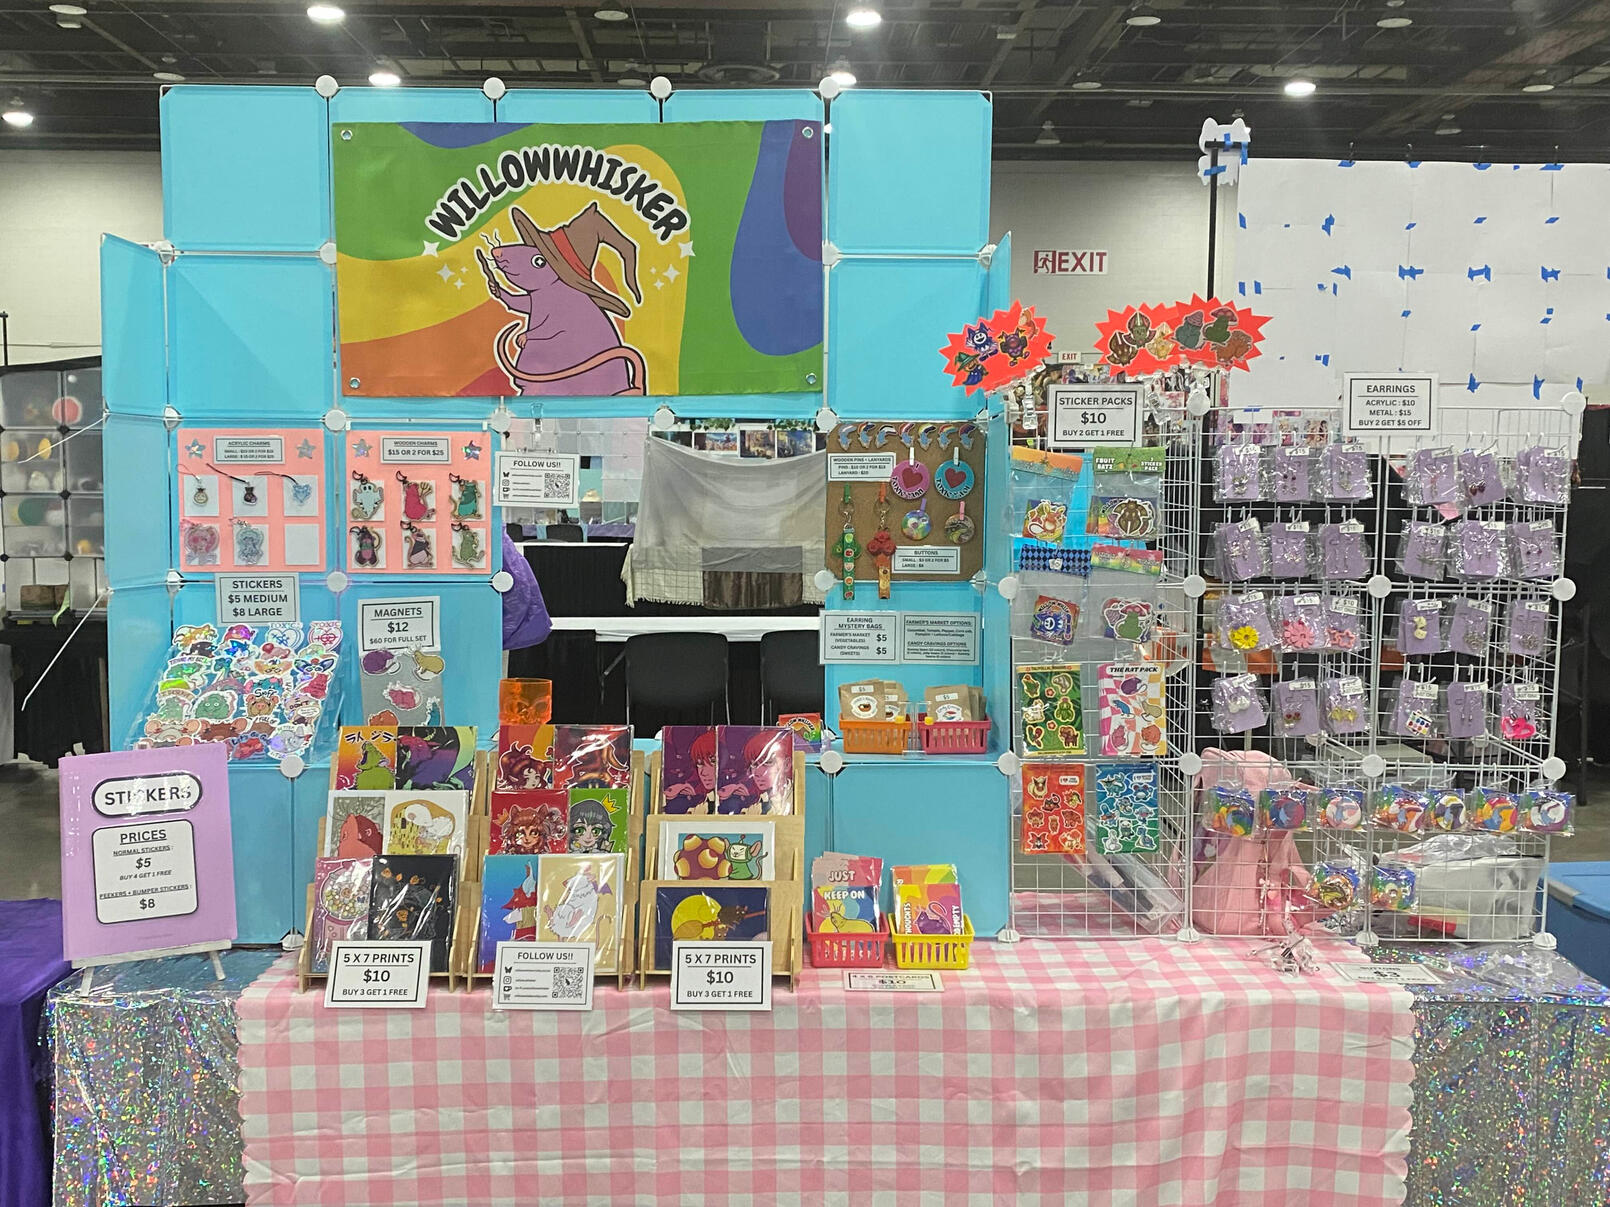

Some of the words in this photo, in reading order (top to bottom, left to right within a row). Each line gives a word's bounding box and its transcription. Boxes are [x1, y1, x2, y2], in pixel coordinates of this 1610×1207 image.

[428, 146, 688, 242] WILLOWWHISKER
[1058, 252, 1107, 272] EXIT
[1367, 385, 1415, 393] EARRINGS
[1059, 397, 1099, 405] STICKER
[1081, 411, 1106, 425] $10
[232, 580, 283, 589] STICKERS
[228, 594, 240, 604] $5
[244, 594, 288, 603] MEDIUM
[233, 608, 245, 617] $8
[248, 608, 282, 616] LARGE
[374, 607, 422, 617] MAGNETS
[388, 621, 408, 634] $12
[876, 634, 887, 642] $5
[876, 647, 887, 655] $5
[120, 829, 166, 843] PRICES
[113, 848, 140, 856] NORMAL
[141, 845, 170, 854] STICKERS
[136, 857, 151, 869] $5
[828, 870, 856, 883] JUST
[99, 891, 127, 899] PEEKERS
[160, 884, 189, 892] STICKERS
[824, 890, 848, 900] KEEP
[850, 890, 865, 899] ON
[139, 898, 155, 910] $8
[952, 905, 960, 928] EMPTY
[344, 954, 350, 963] 5
[353, 954, 361, 963] X
[364, 954, 370, 963] 7
[373, 954, 414, 963] PRINTS
[518, 952, 554, 960] FOLLOW
[685, 954, 692, 964] 5
[695, 954, 702, 964] X
[706, 954, 711, 964] 7
[714, 954, 756, 964] PRINTS
[363, 969, 390, 983] $10
[706, 970, 734, 985] $10
